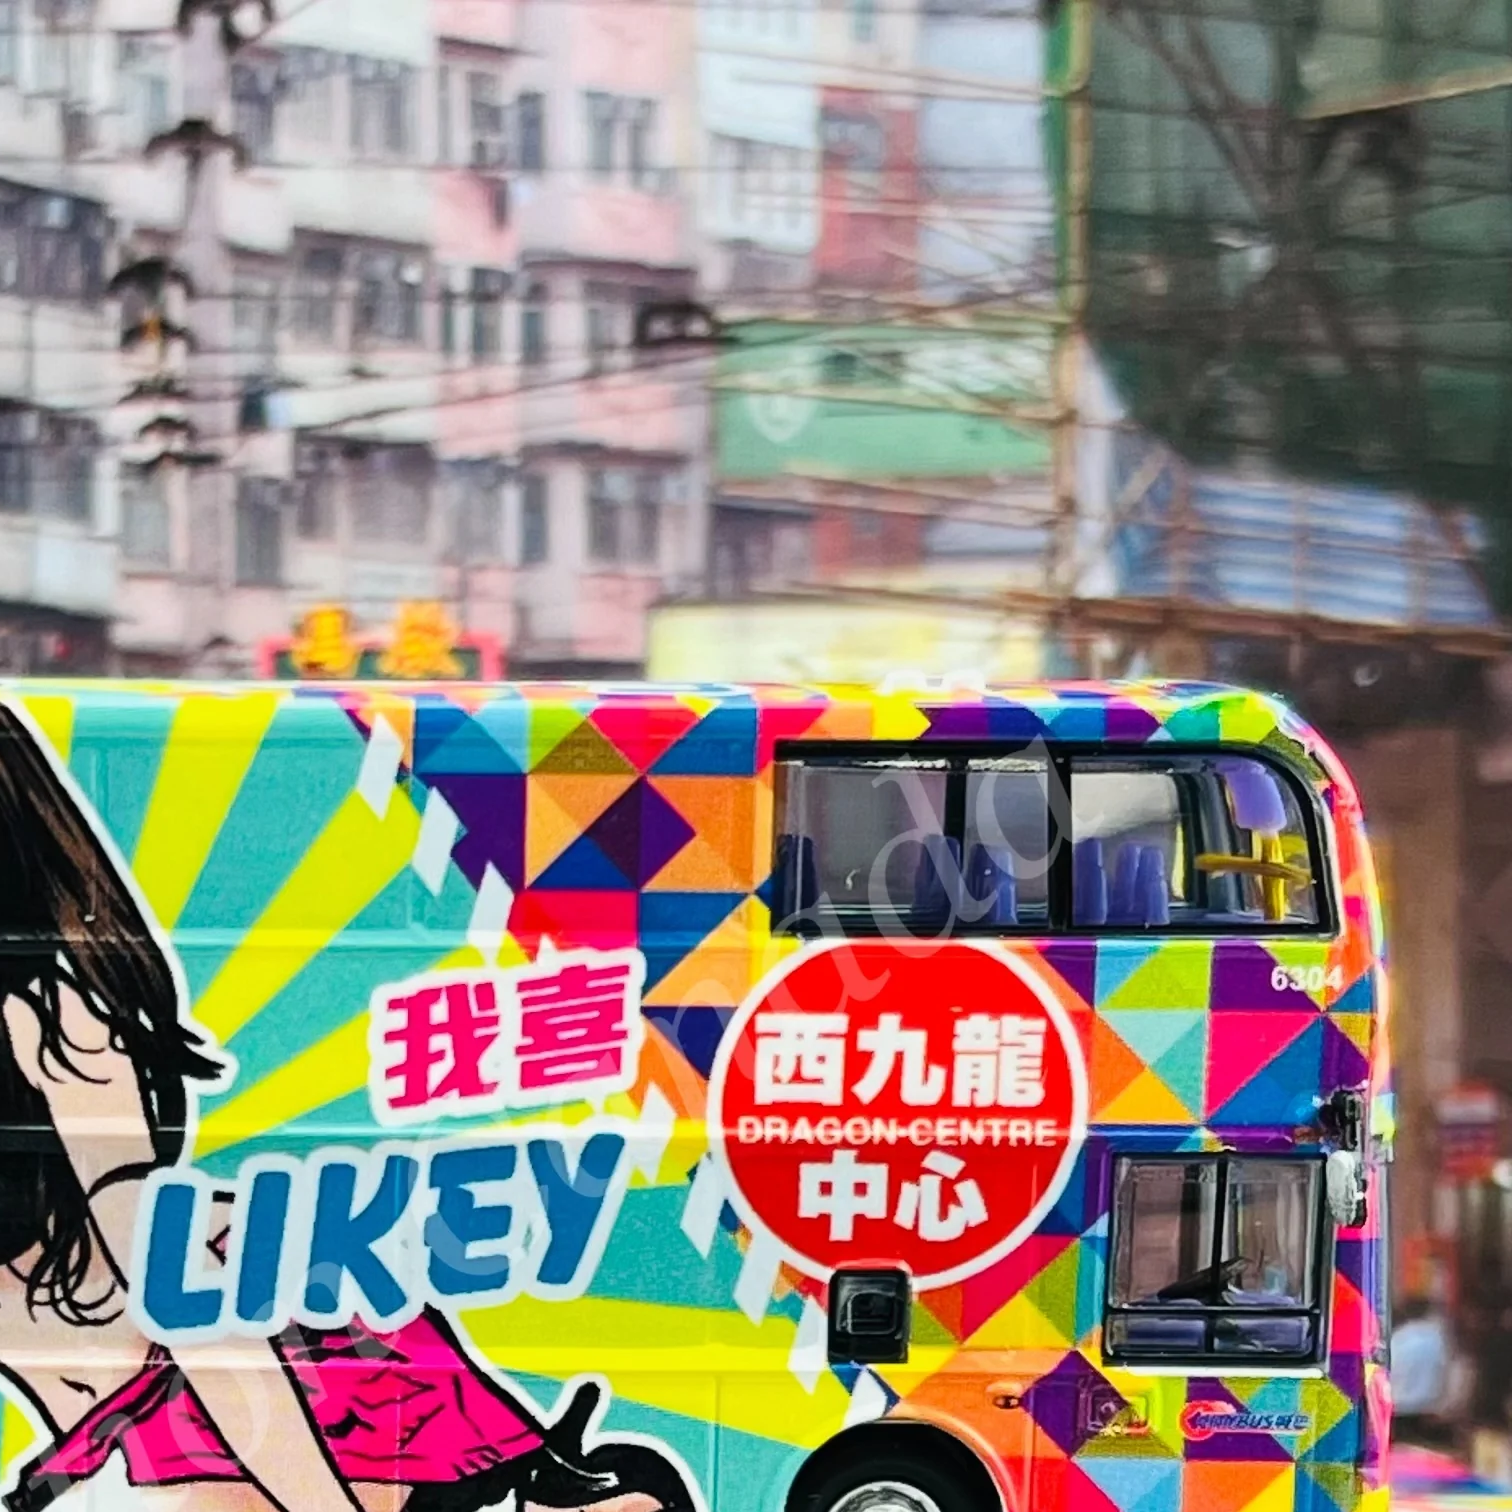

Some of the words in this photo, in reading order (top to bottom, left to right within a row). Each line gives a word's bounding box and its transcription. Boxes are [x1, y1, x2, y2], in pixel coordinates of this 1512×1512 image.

[1271, 965, 1344, 992] 6304
[385, 962, 632, 1112] 我喜
[753, 1013, 1047, 1108] 西九龍
[140, 1131, 626, 1332] LIKEY
[797, 1149, 988, 1242] 中心
